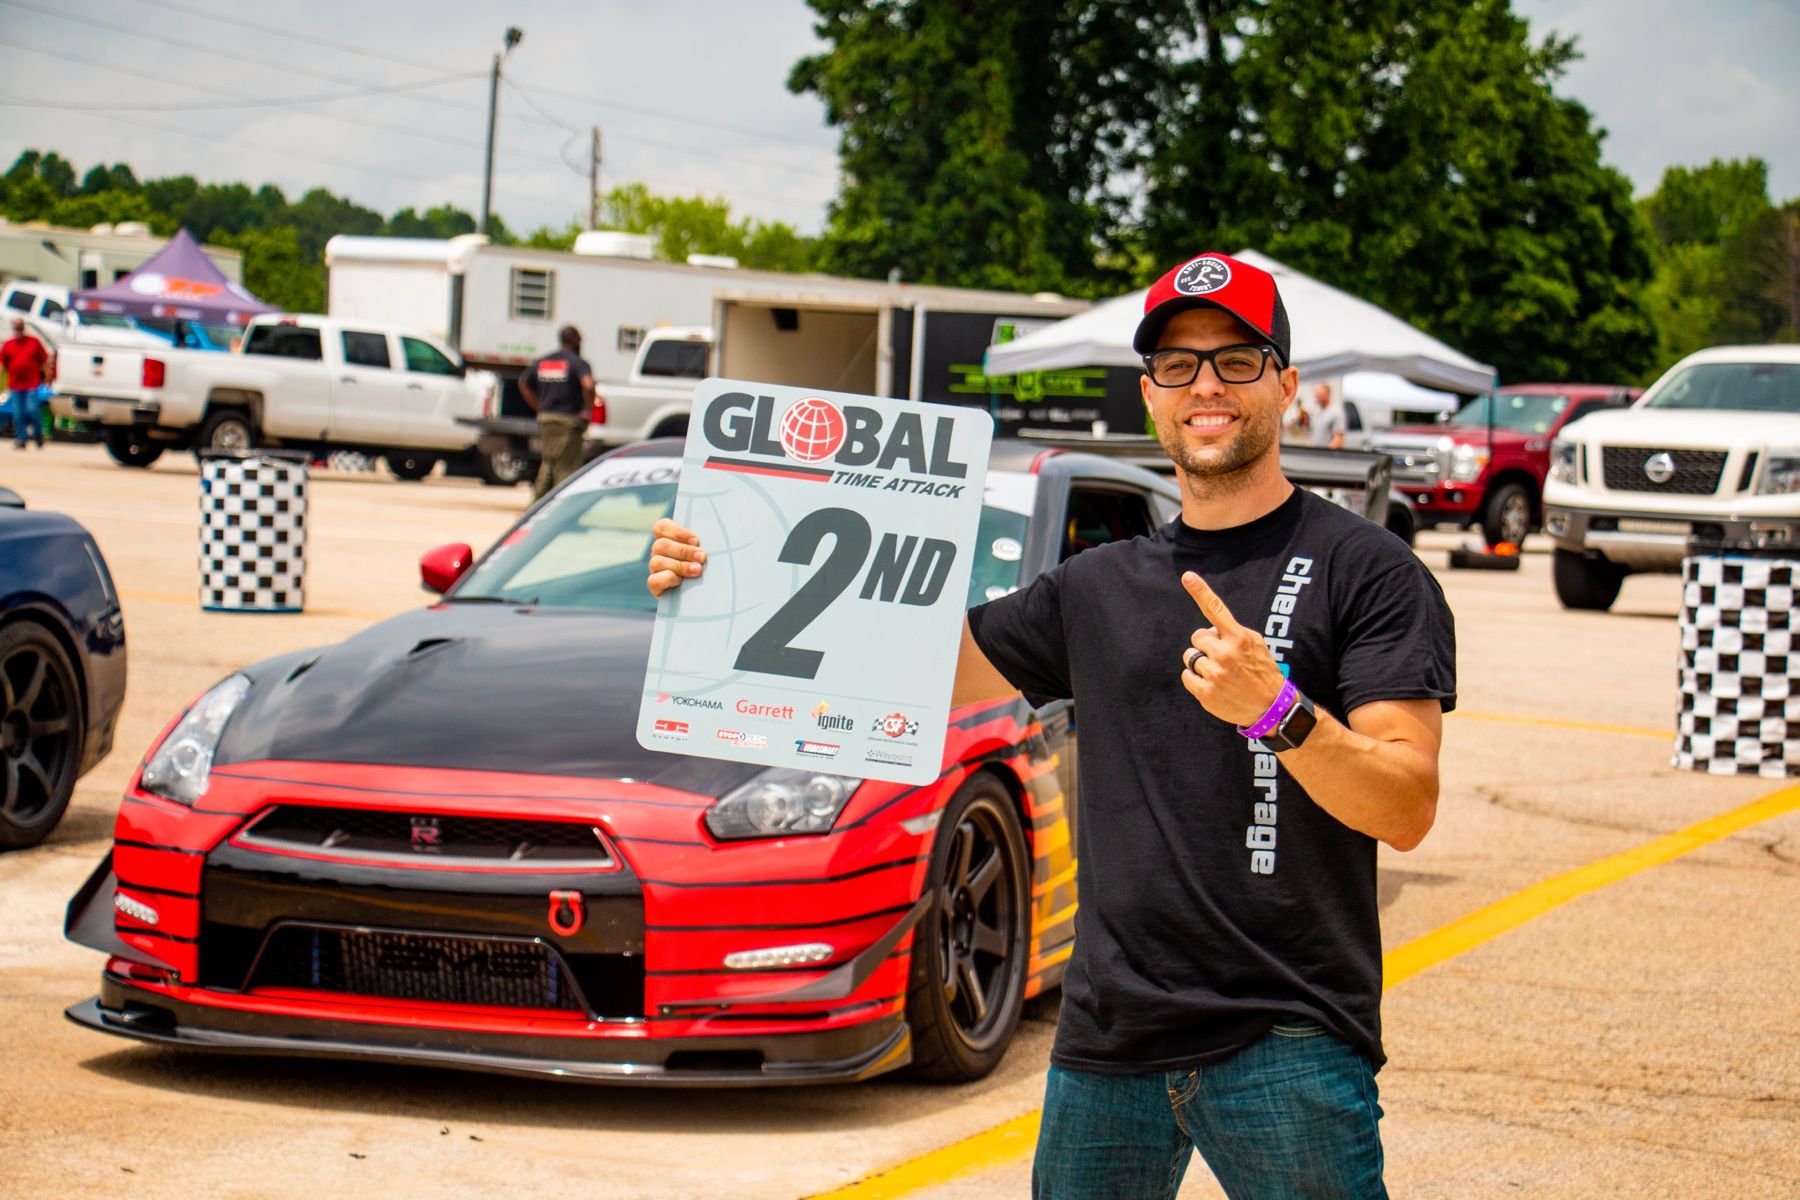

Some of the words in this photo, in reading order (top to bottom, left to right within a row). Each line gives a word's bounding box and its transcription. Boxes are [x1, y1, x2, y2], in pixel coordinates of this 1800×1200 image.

[703, 392, 968, 479] GLOBAL
[601, 467, 682, 487] GLO
[834, 471, 885, 490] TIME
[883, 476, 966, 499] ATTACK
[671, 695, 723, 710] YOKOHAMA
[736, 699, 794, 720] Garrett
[817, 712, 854, 732] ignite
[883, 718, 905, 733] CSF
